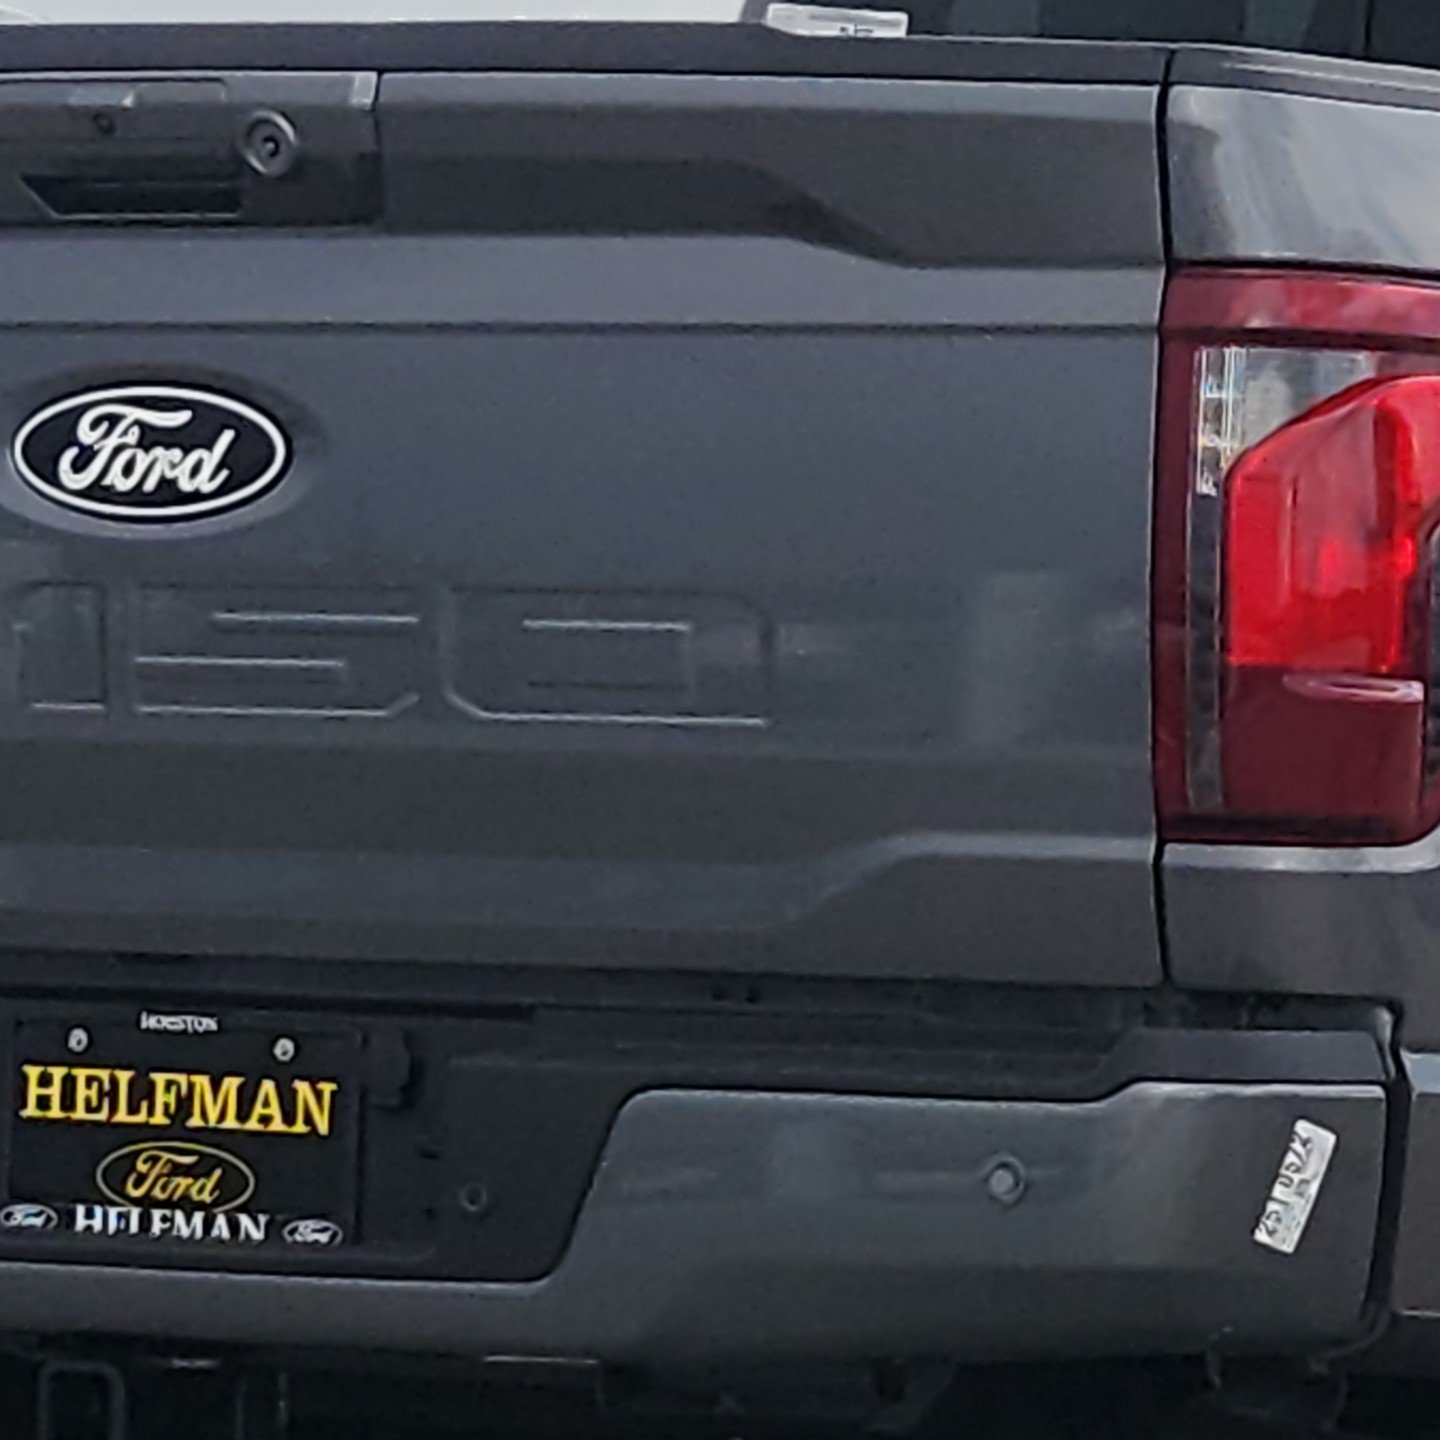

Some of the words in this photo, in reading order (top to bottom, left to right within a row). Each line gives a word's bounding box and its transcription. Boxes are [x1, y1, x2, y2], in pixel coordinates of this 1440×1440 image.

[58, 403, 236, 494] Ford
[18, 1063, 339, 1136] HELFMAN
[124, 1149, 222, 1204] Ford
